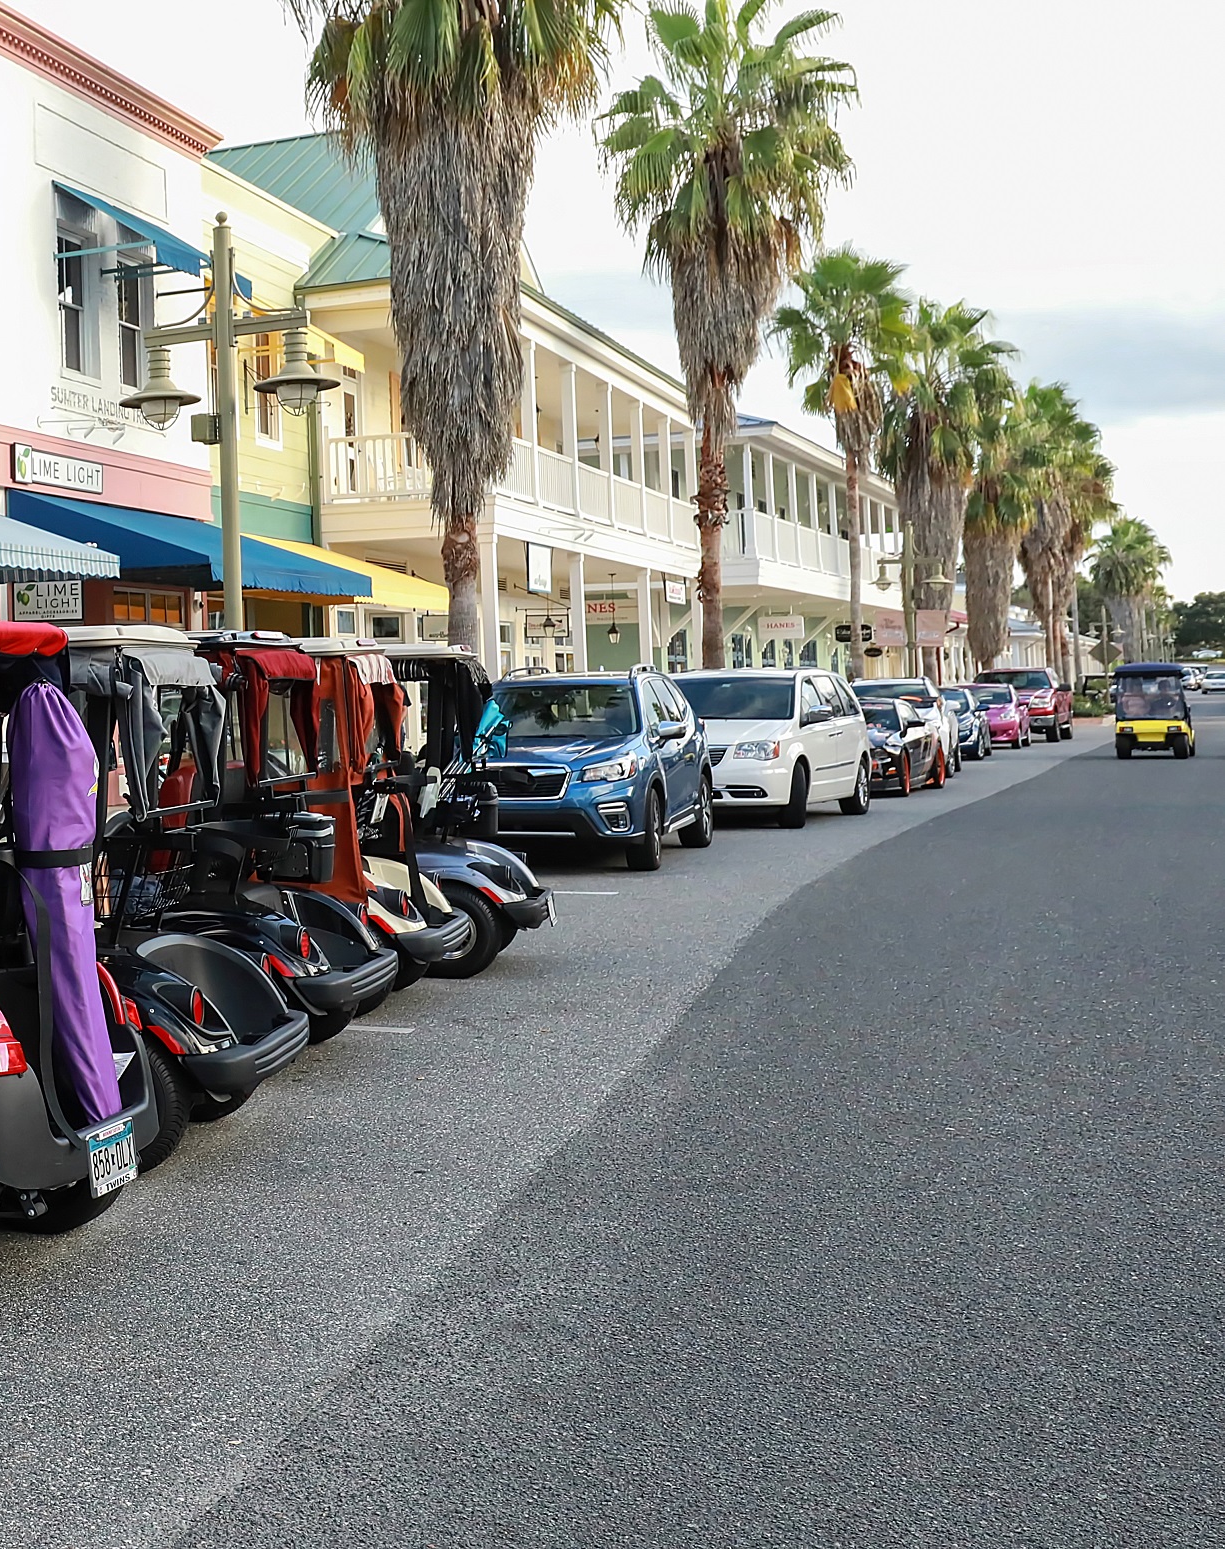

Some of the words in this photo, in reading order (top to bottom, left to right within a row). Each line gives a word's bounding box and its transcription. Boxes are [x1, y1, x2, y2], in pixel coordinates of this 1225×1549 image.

[50, 386, 89, 410] SUMTER
[31, 457, 60, 480] LIME
[66, 463, 101, 487] LIGHT
[36, 582, 80, 597] LIME
[36, 597, 80, 609] LIGHT
[586, 602, 616, 614] NES
[106, 1173, 131, 1191] TWINS
